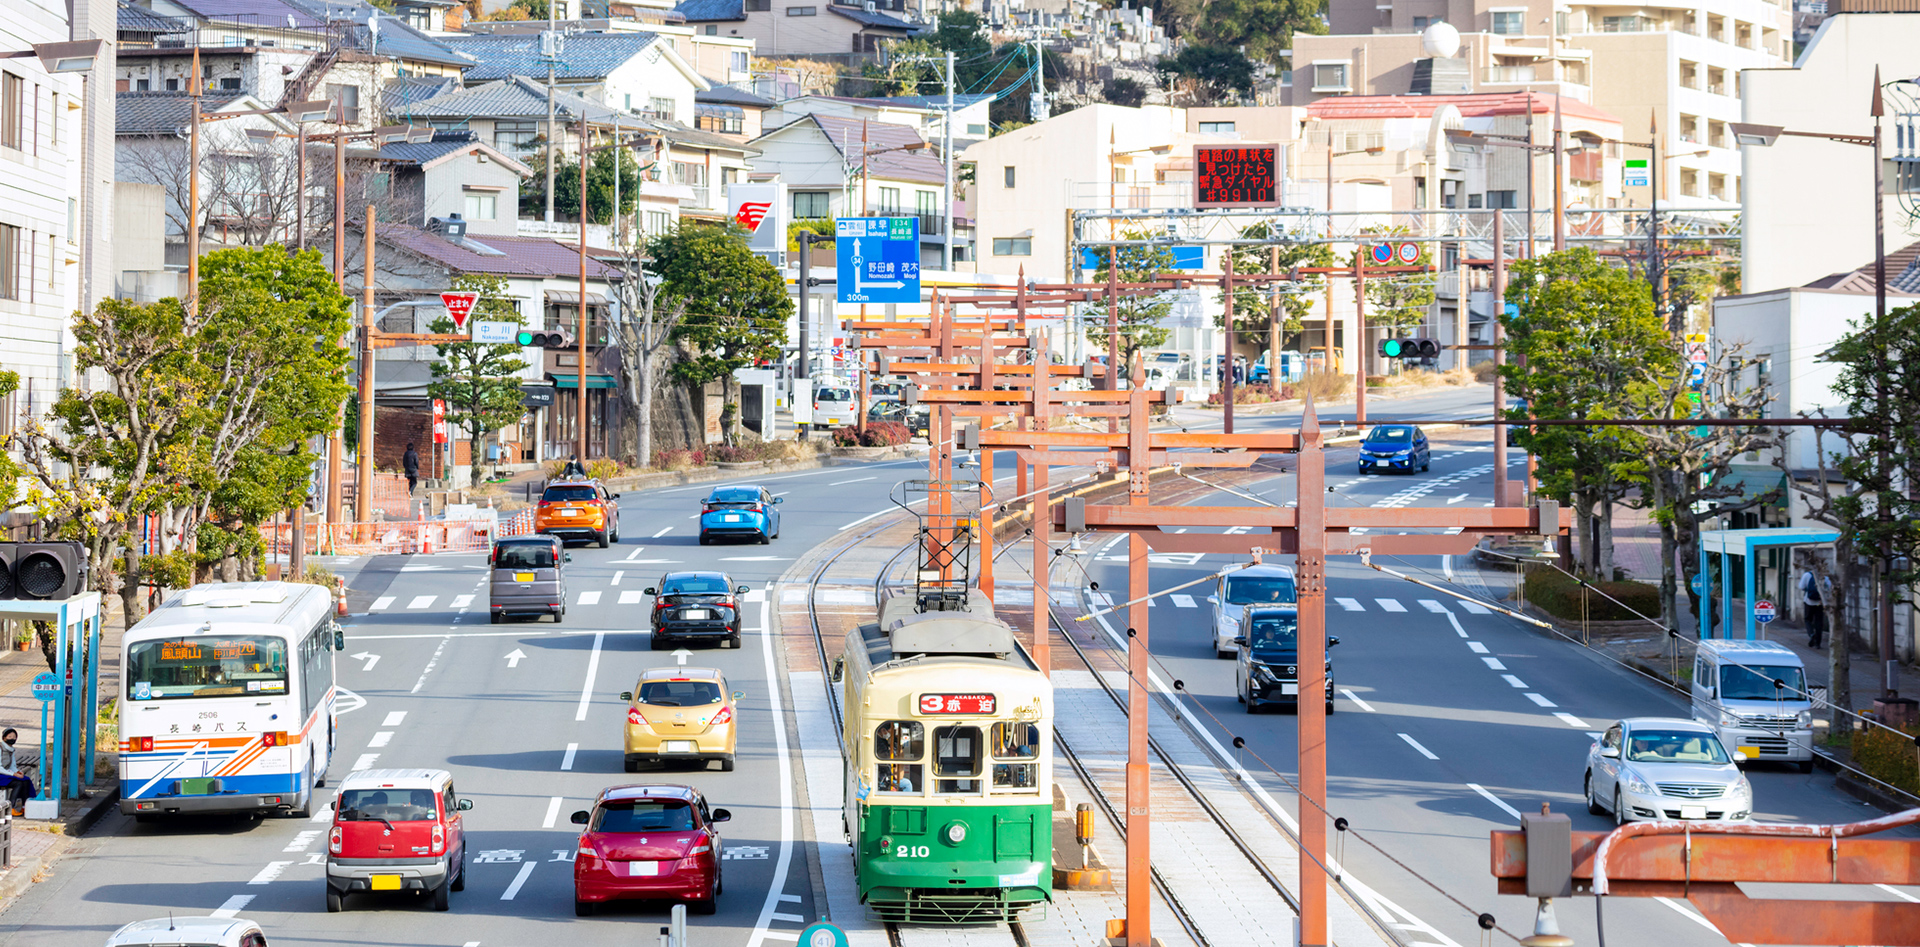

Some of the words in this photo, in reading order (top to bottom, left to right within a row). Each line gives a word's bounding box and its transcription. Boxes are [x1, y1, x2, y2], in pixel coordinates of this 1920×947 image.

[1199, 149, 1273, 162] 道路の異状を
[1206, 162, 1267, 175] 見つけたら
[1199, 175, 1274, 189] 緊急ダイヤル
[1403, 247, 1415, 257] 50
[901, 262, 918, 273] 茂木
[448, 299, 469, 308] 止まれ
[161, 647, 202, 660] 風頭山
[240, 643, 253, 653] 70
[921, 695, 944, 711] 3
[947, 699, 994, 712] 赤迫
[170, 722, 247, 733] 長崎バス
[896, 845, 930, 858] 210
[817, 937, 829, 946] 41
